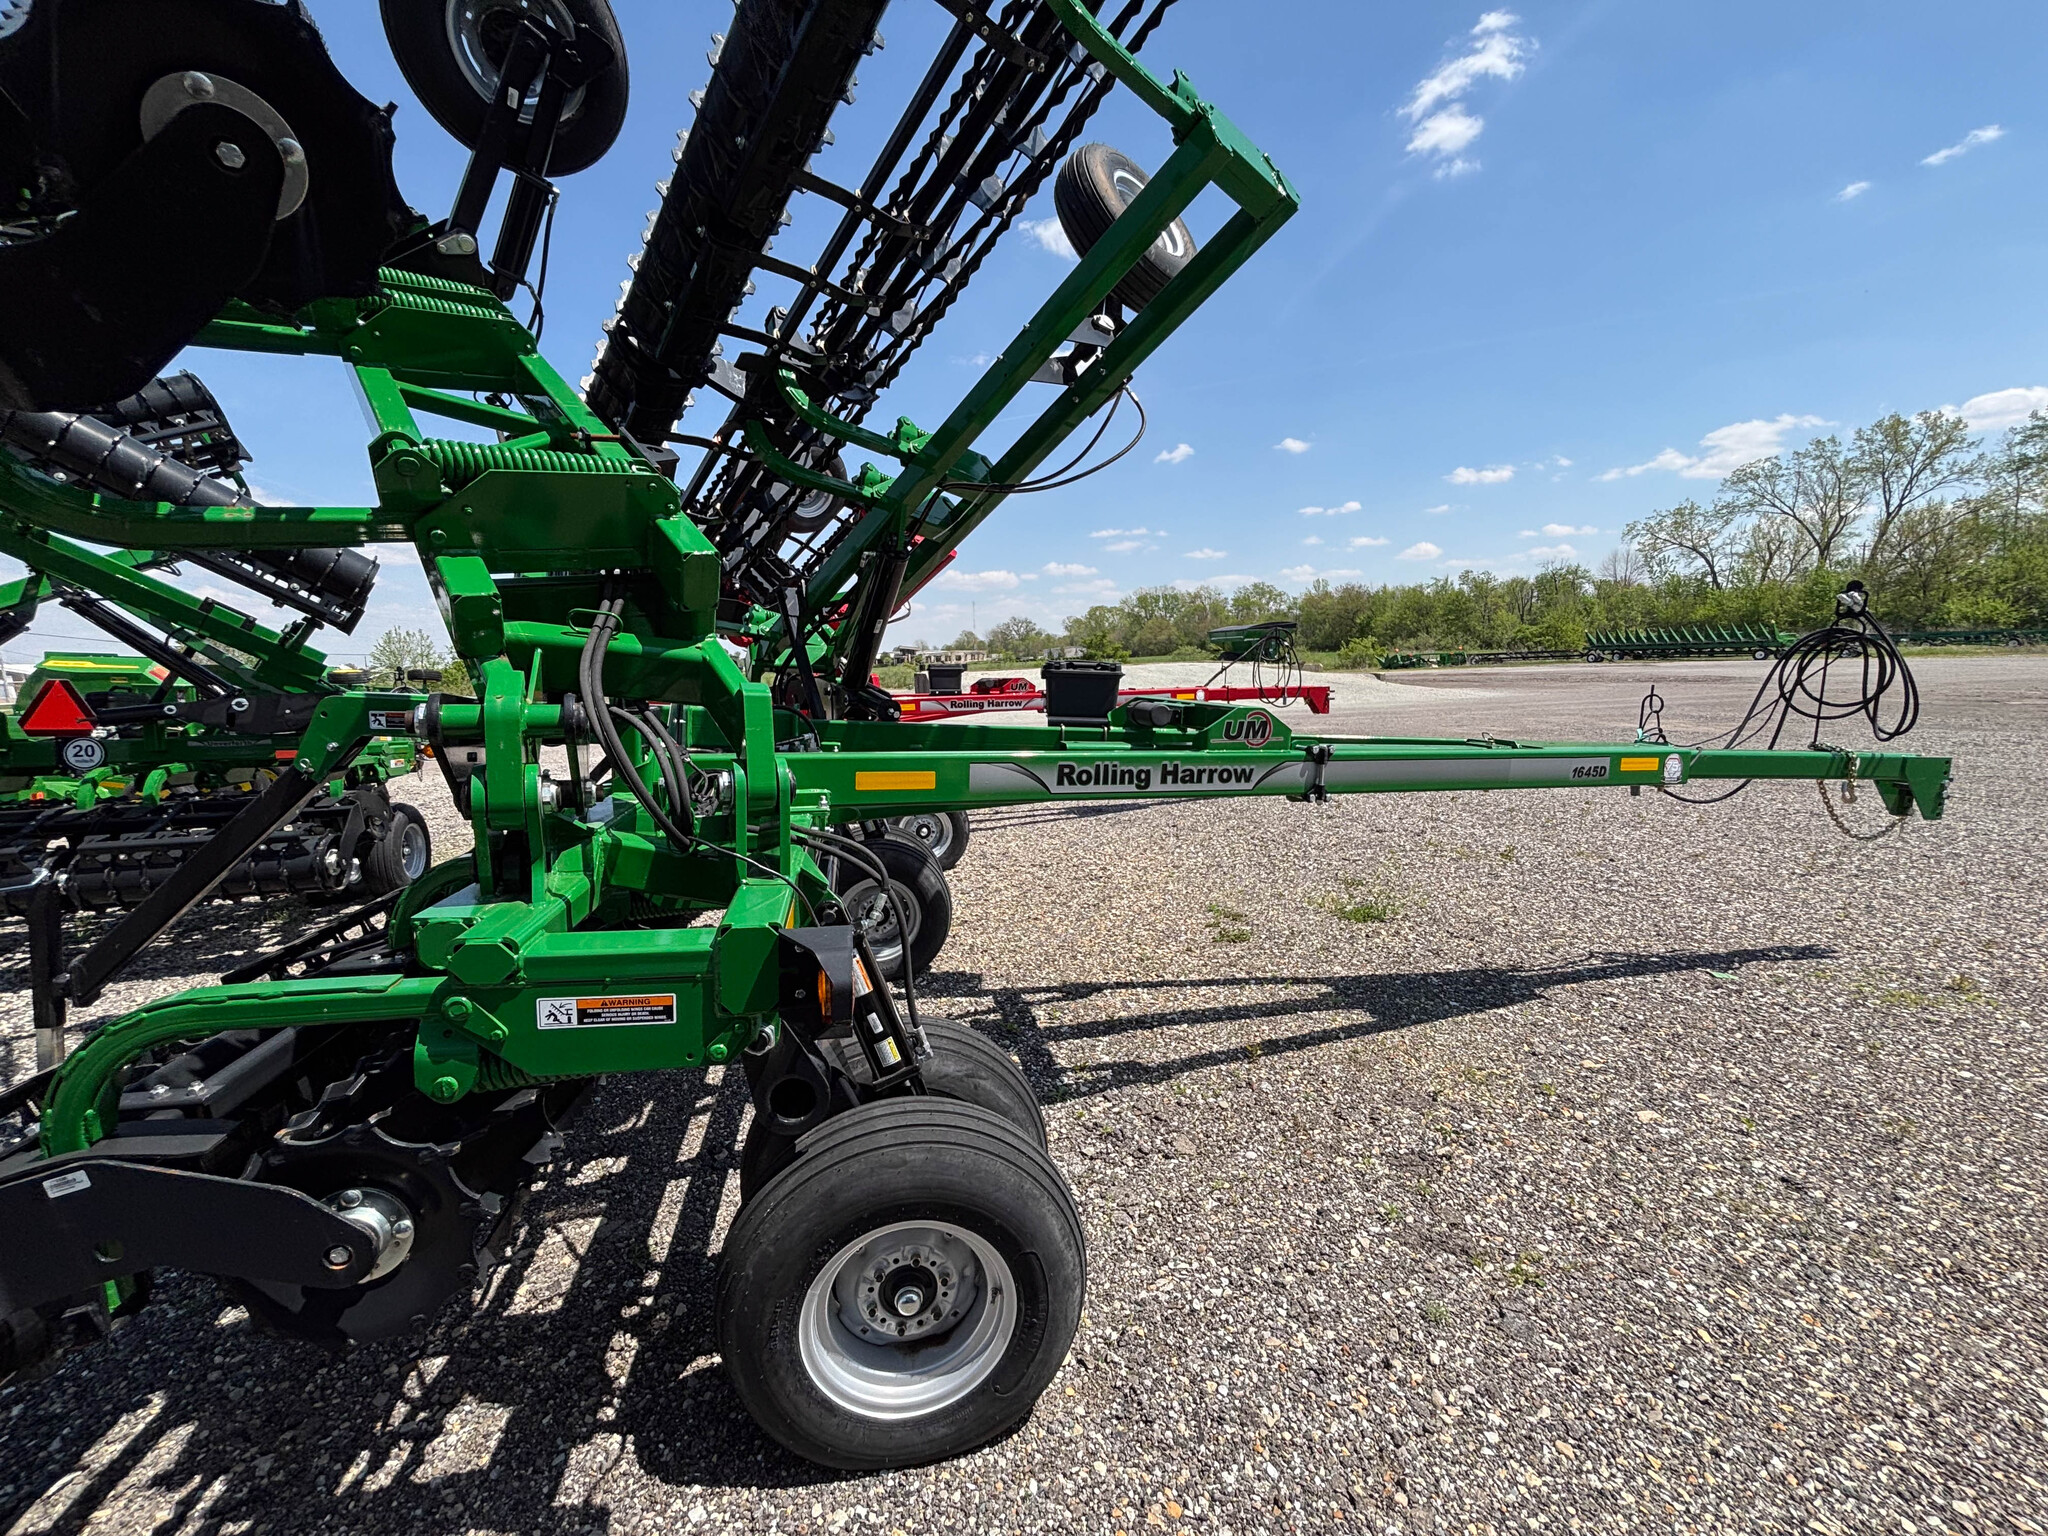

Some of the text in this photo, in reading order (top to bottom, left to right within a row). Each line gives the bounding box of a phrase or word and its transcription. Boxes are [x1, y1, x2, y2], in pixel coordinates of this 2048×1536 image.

[1010, 683, 1028, 691] UM
[950, 699, 1023, 709] Rolling Harrow
[1223, 720, 1269, 740] UM
[72, 744, 96, 758] 20
[1056, 763, 1255, 790] Rolling Harrow
[1571, 765, 1607, 779] 1645D
[608, 998, 651, 1006] WARNING
